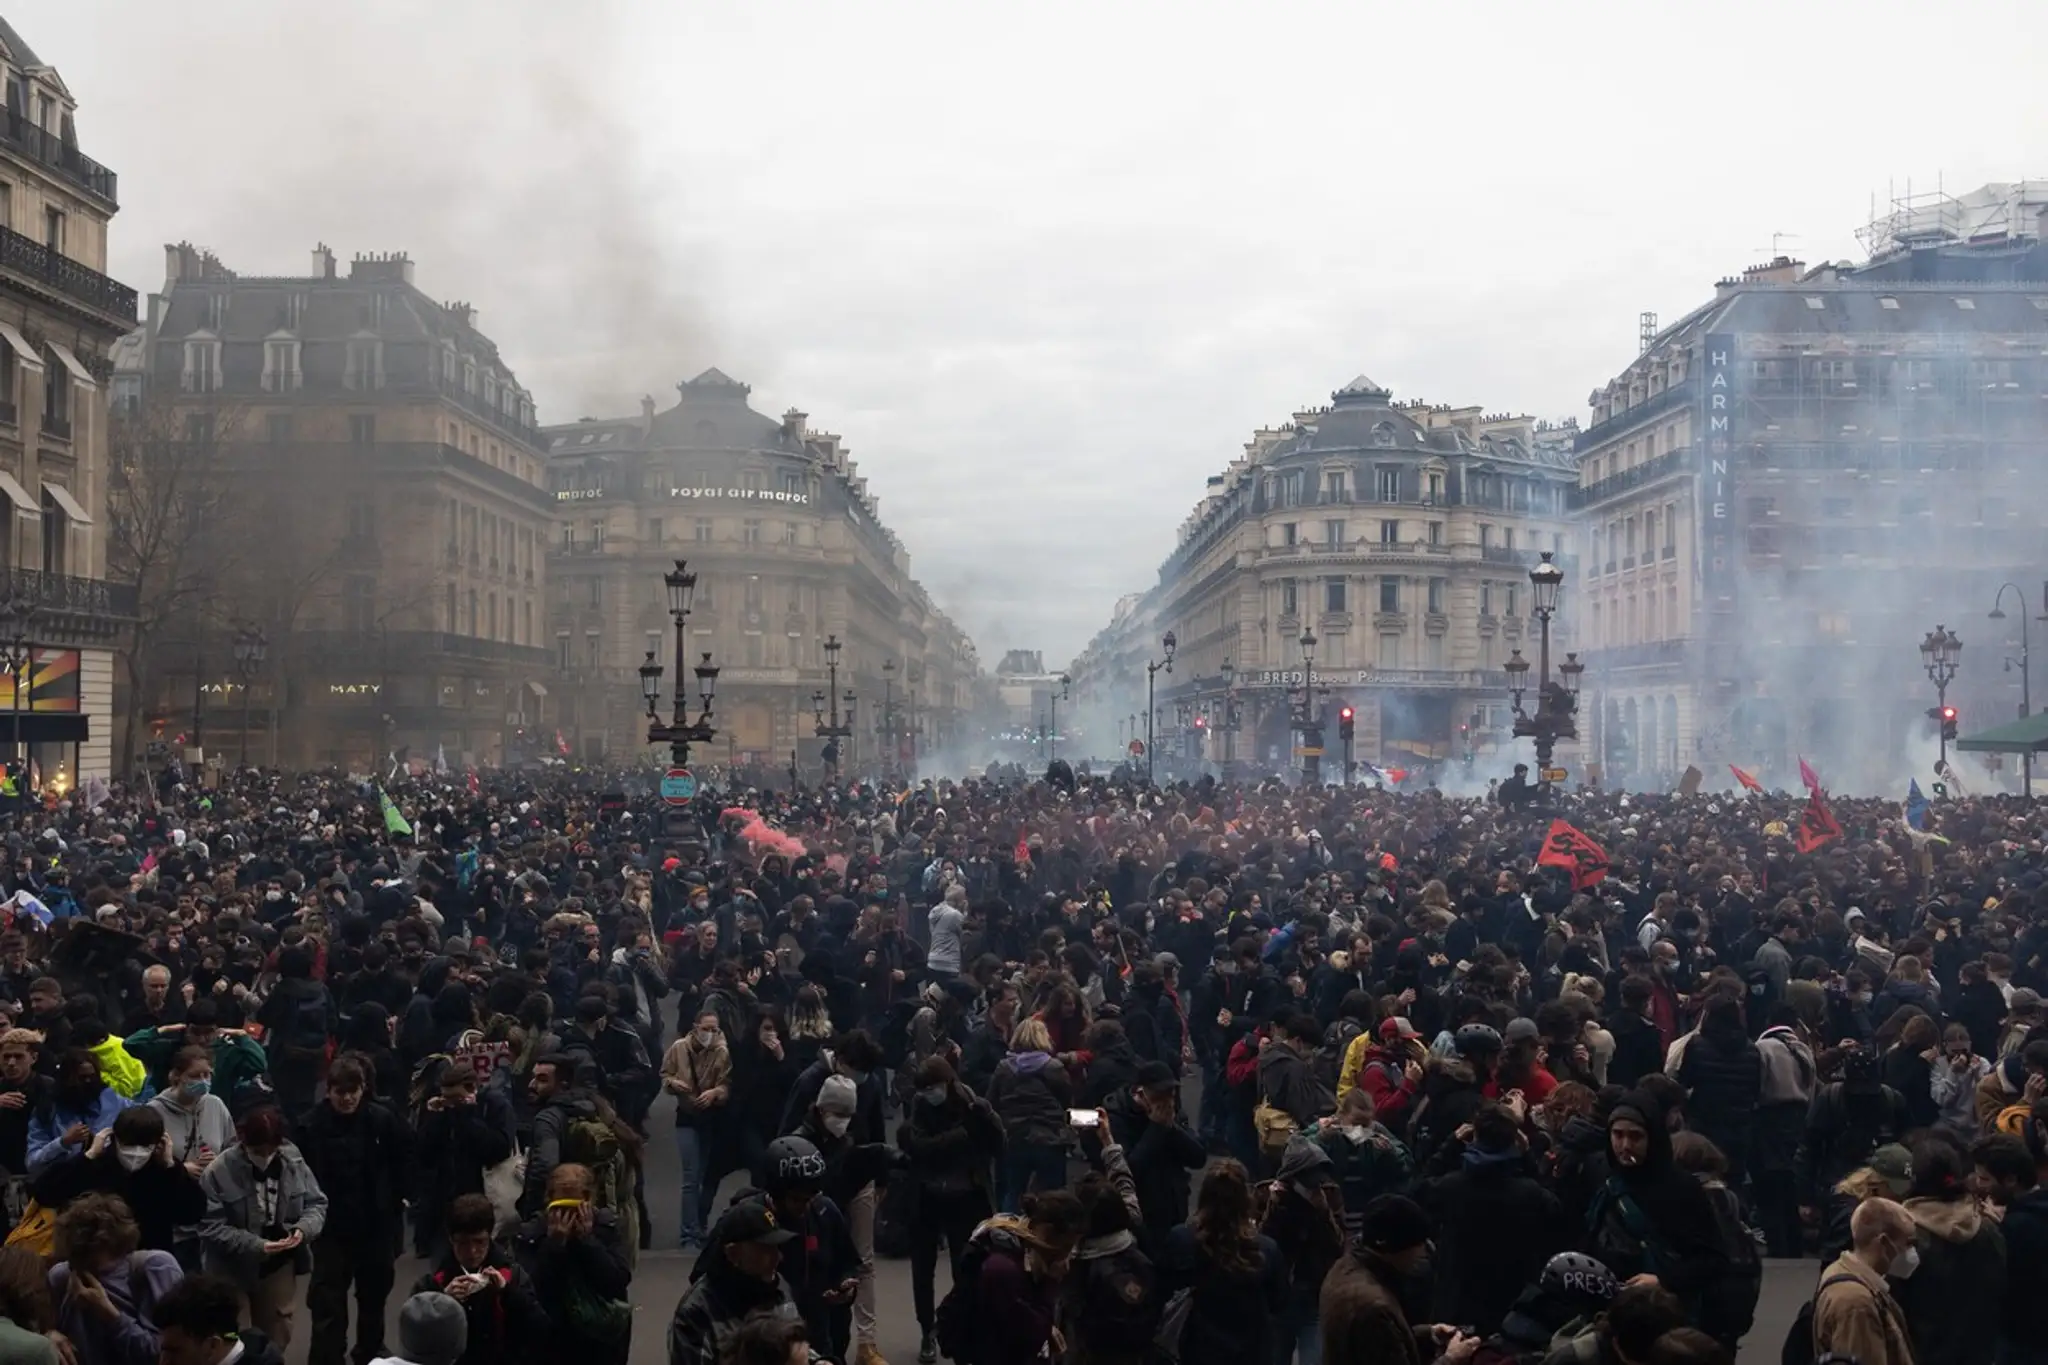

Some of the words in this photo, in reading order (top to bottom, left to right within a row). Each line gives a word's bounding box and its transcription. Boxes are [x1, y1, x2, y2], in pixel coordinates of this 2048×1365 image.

[558, 488, 604, 500] maroc
[671, 487, 722, 498] royal
[727, 487, 755, 498] air
[759, 489, 808, 504] maroc
[330, 684, 380, 694] MATY
[1563, 1271, 1614, 1299] PRESS
